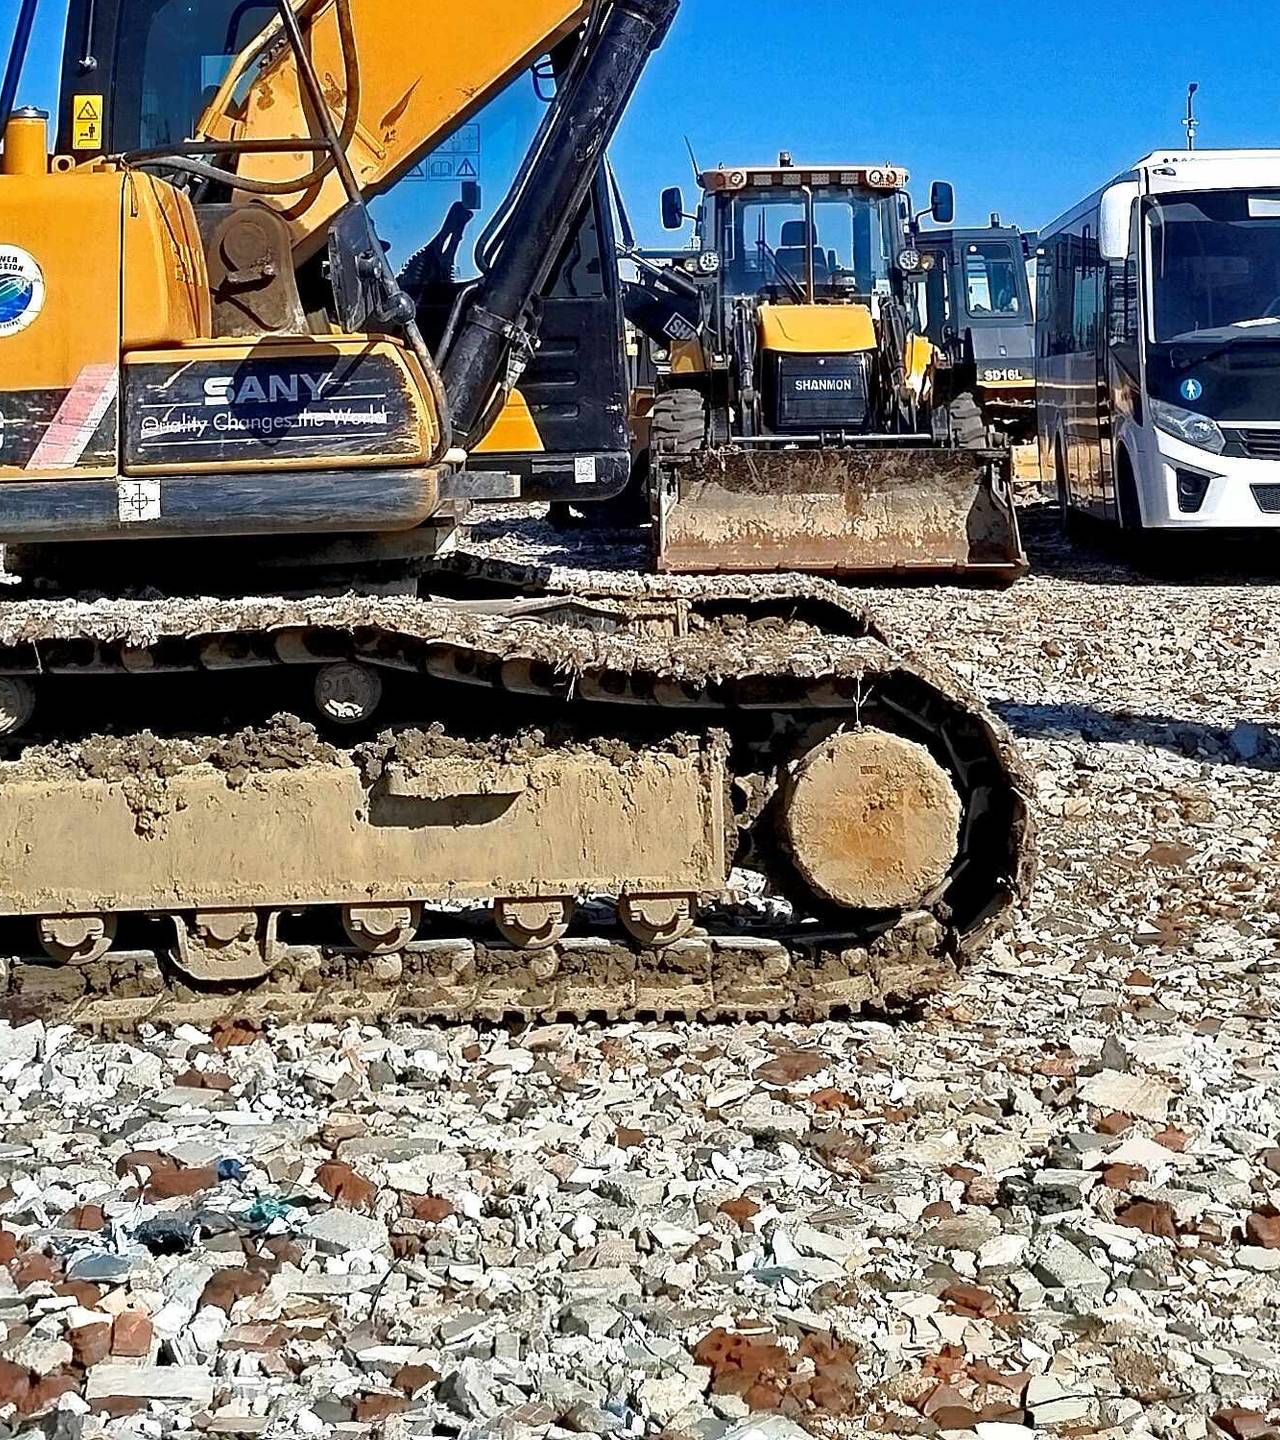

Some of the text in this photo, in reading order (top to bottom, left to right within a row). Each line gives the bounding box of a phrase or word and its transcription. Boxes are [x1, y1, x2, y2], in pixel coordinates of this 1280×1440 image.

[204, 372, 330, 406] SANY
[795, 379, 851, 391] SHANMON
[141, 413, 208, 438] Quality
[214, 411, 293, 434] Changes
[297, 408, 324, 428] the
